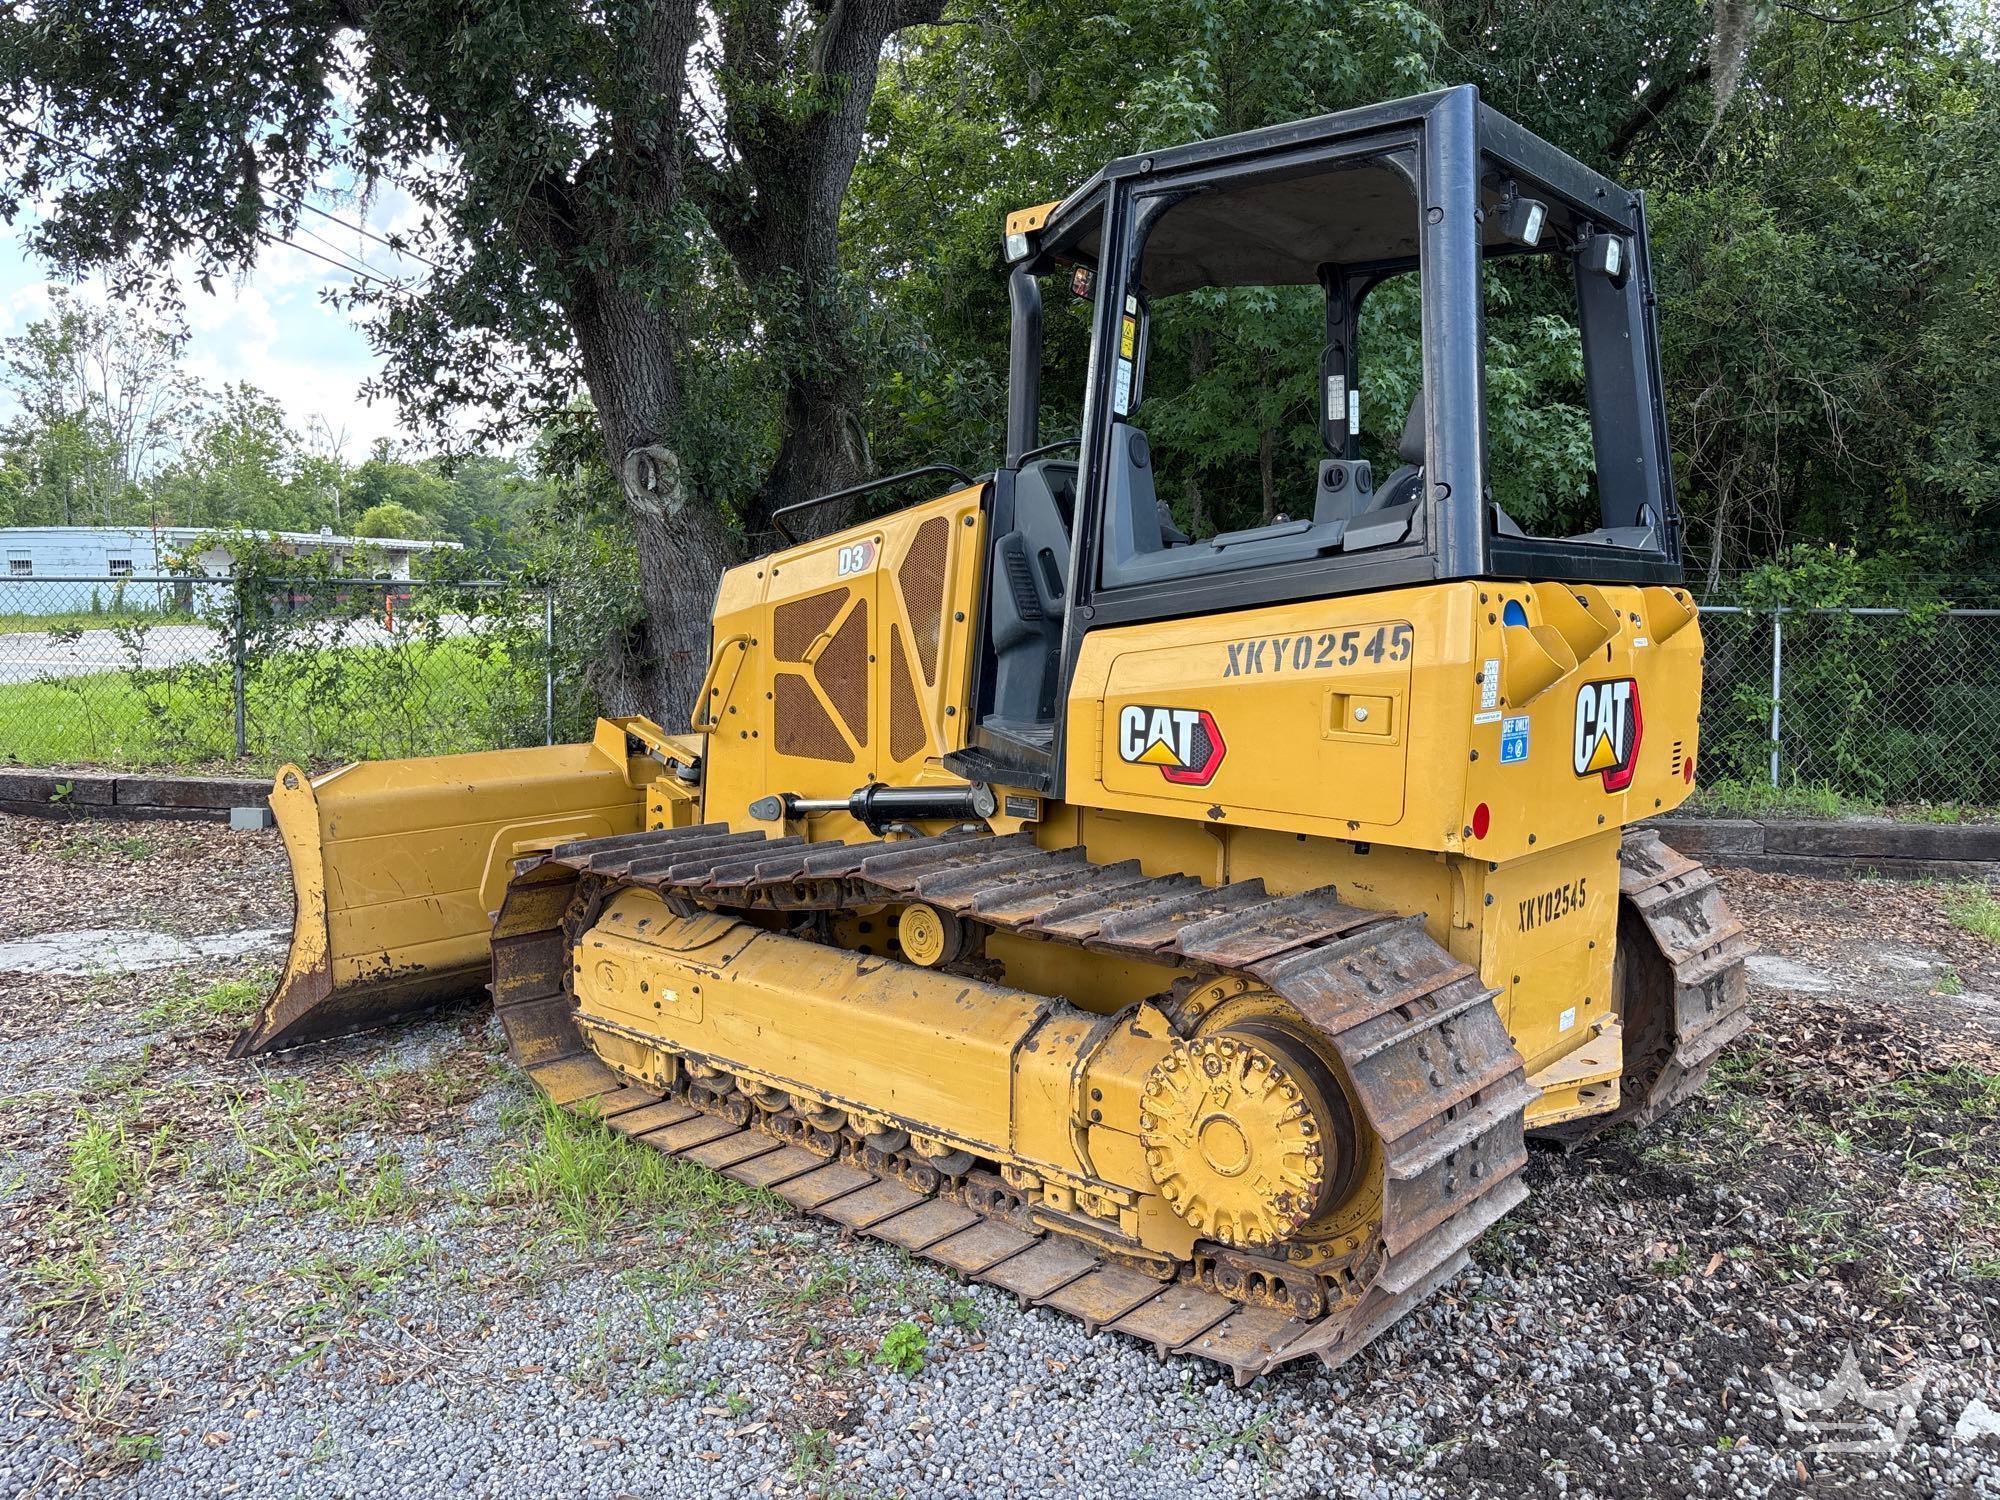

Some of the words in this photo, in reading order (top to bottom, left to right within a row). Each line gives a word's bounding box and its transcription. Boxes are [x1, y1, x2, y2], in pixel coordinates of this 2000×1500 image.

[839, 544, 864, 575] D3
[1223, 626, 1411, 677] XKY02545
[1120, 705, 1199, 767] CAT
[1503, 720, 1515, 733] DEF
[1515, 718, 1528, 732] ONLY
[1575, 681, 1630, 773] CAT
[1518, 878, 1586, 932] XKY02545
